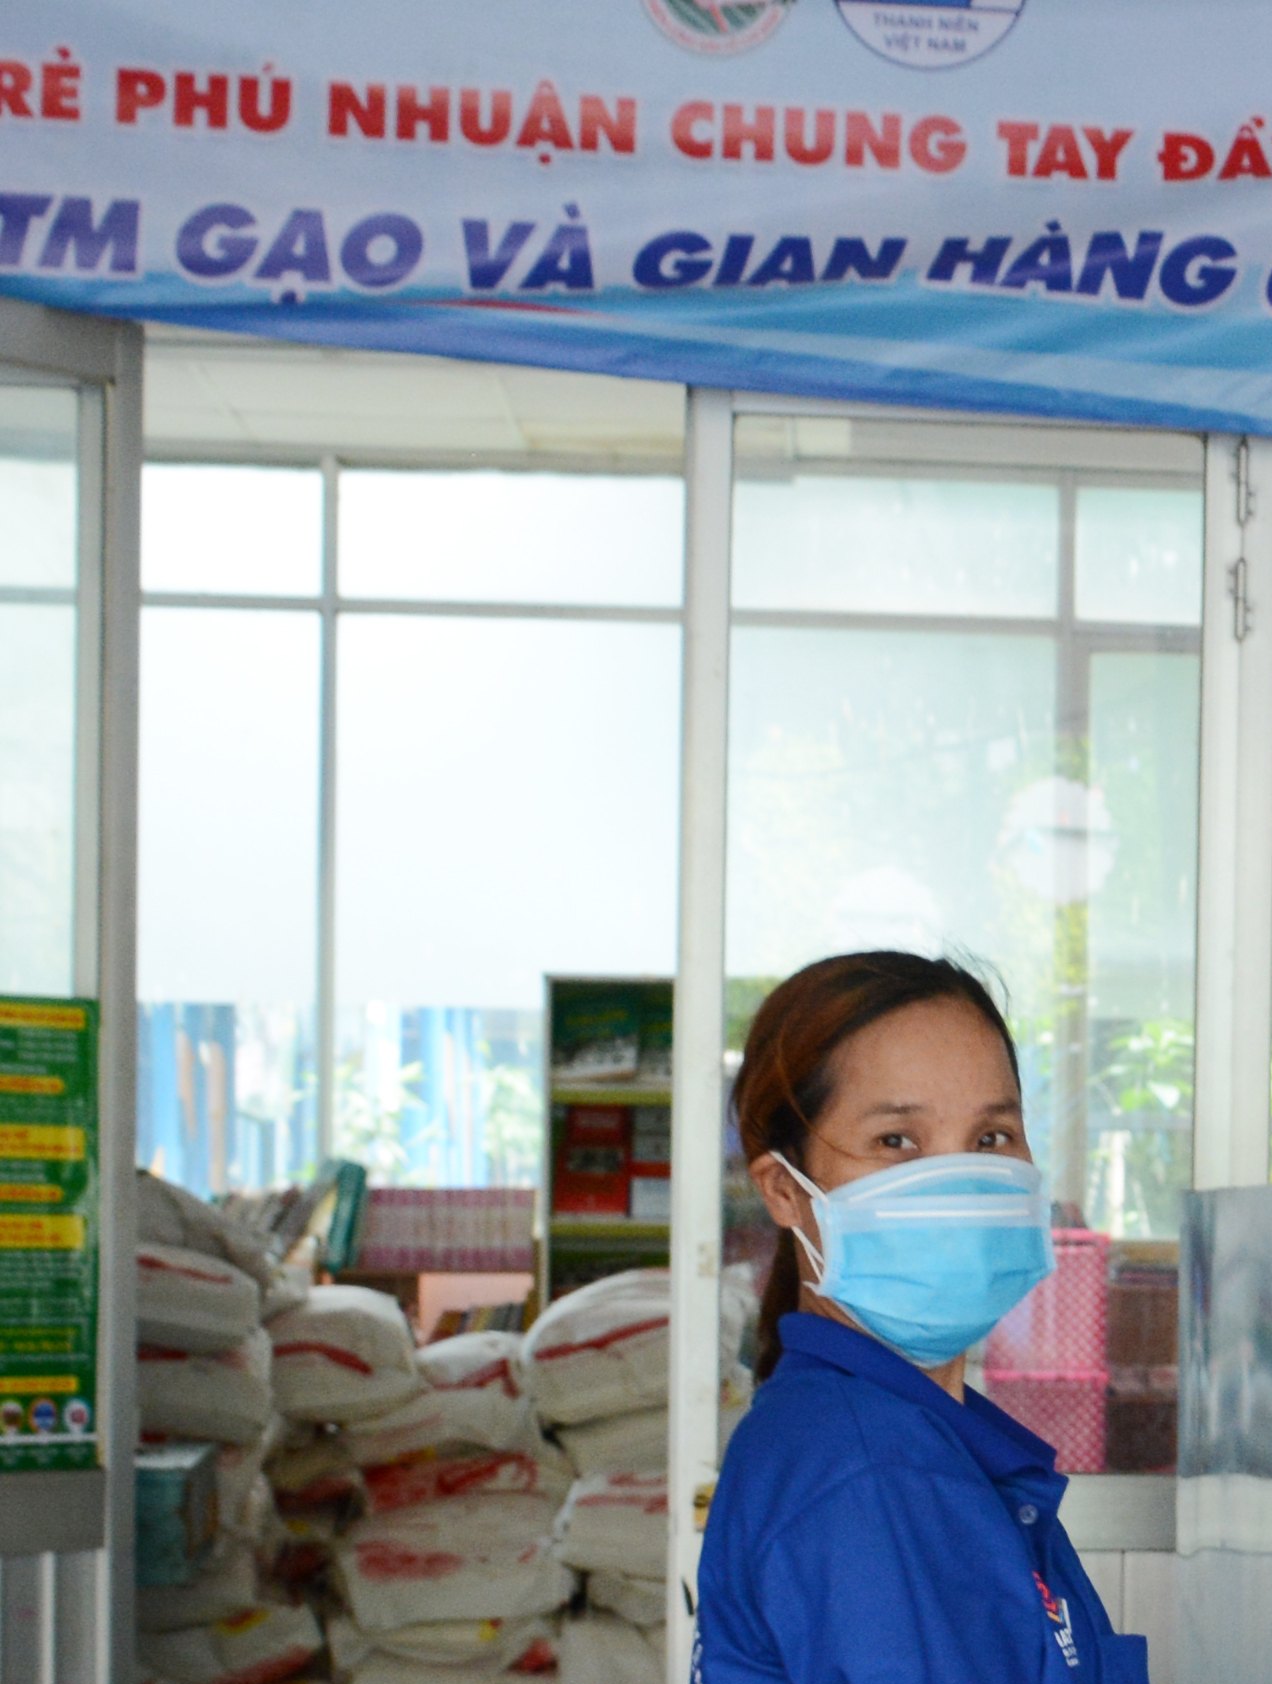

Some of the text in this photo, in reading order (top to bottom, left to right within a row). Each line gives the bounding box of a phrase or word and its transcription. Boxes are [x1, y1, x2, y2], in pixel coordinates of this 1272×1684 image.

[115, 62, 292, 133] PHÚ
[328, 79, 637, 165] NHUẬN
[670, 100, 968, 174] CHUNG
[997, 121, 1135, 181] TAY
[175, 202, 424, 304] GẠO
[461, 202, 595, 290] VÀ
[632, 231, 908, 288] GIAN
[926, 219, 1238, 307] HÀNG
